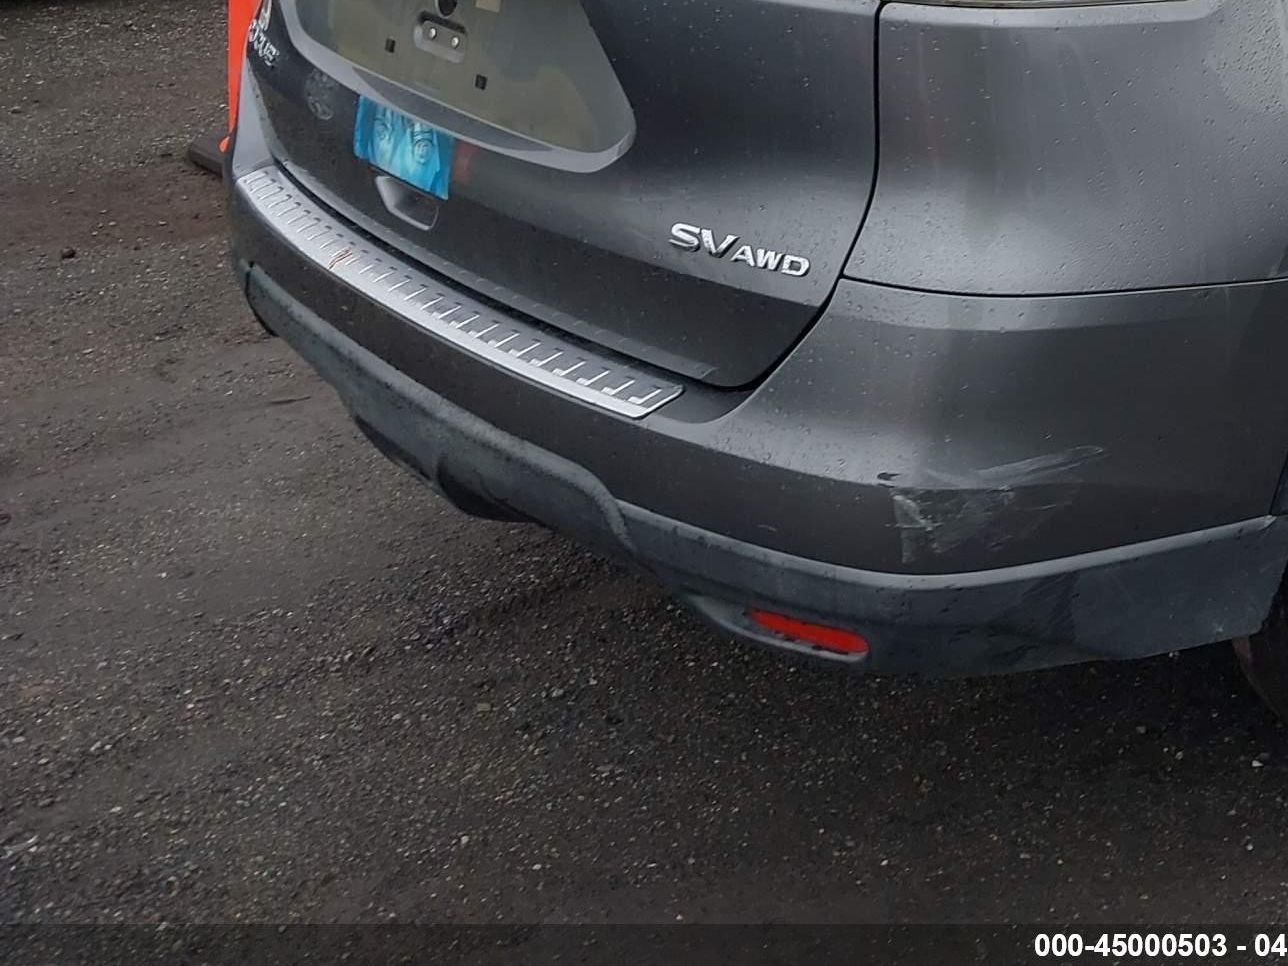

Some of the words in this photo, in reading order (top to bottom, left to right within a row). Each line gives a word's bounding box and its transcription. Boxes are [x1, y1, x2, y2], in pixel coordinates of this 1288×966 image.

[249, 19, 280, 66] OGUE
[668, 222, 740, 258] SV
[730, 245, 810, 277] AWD
